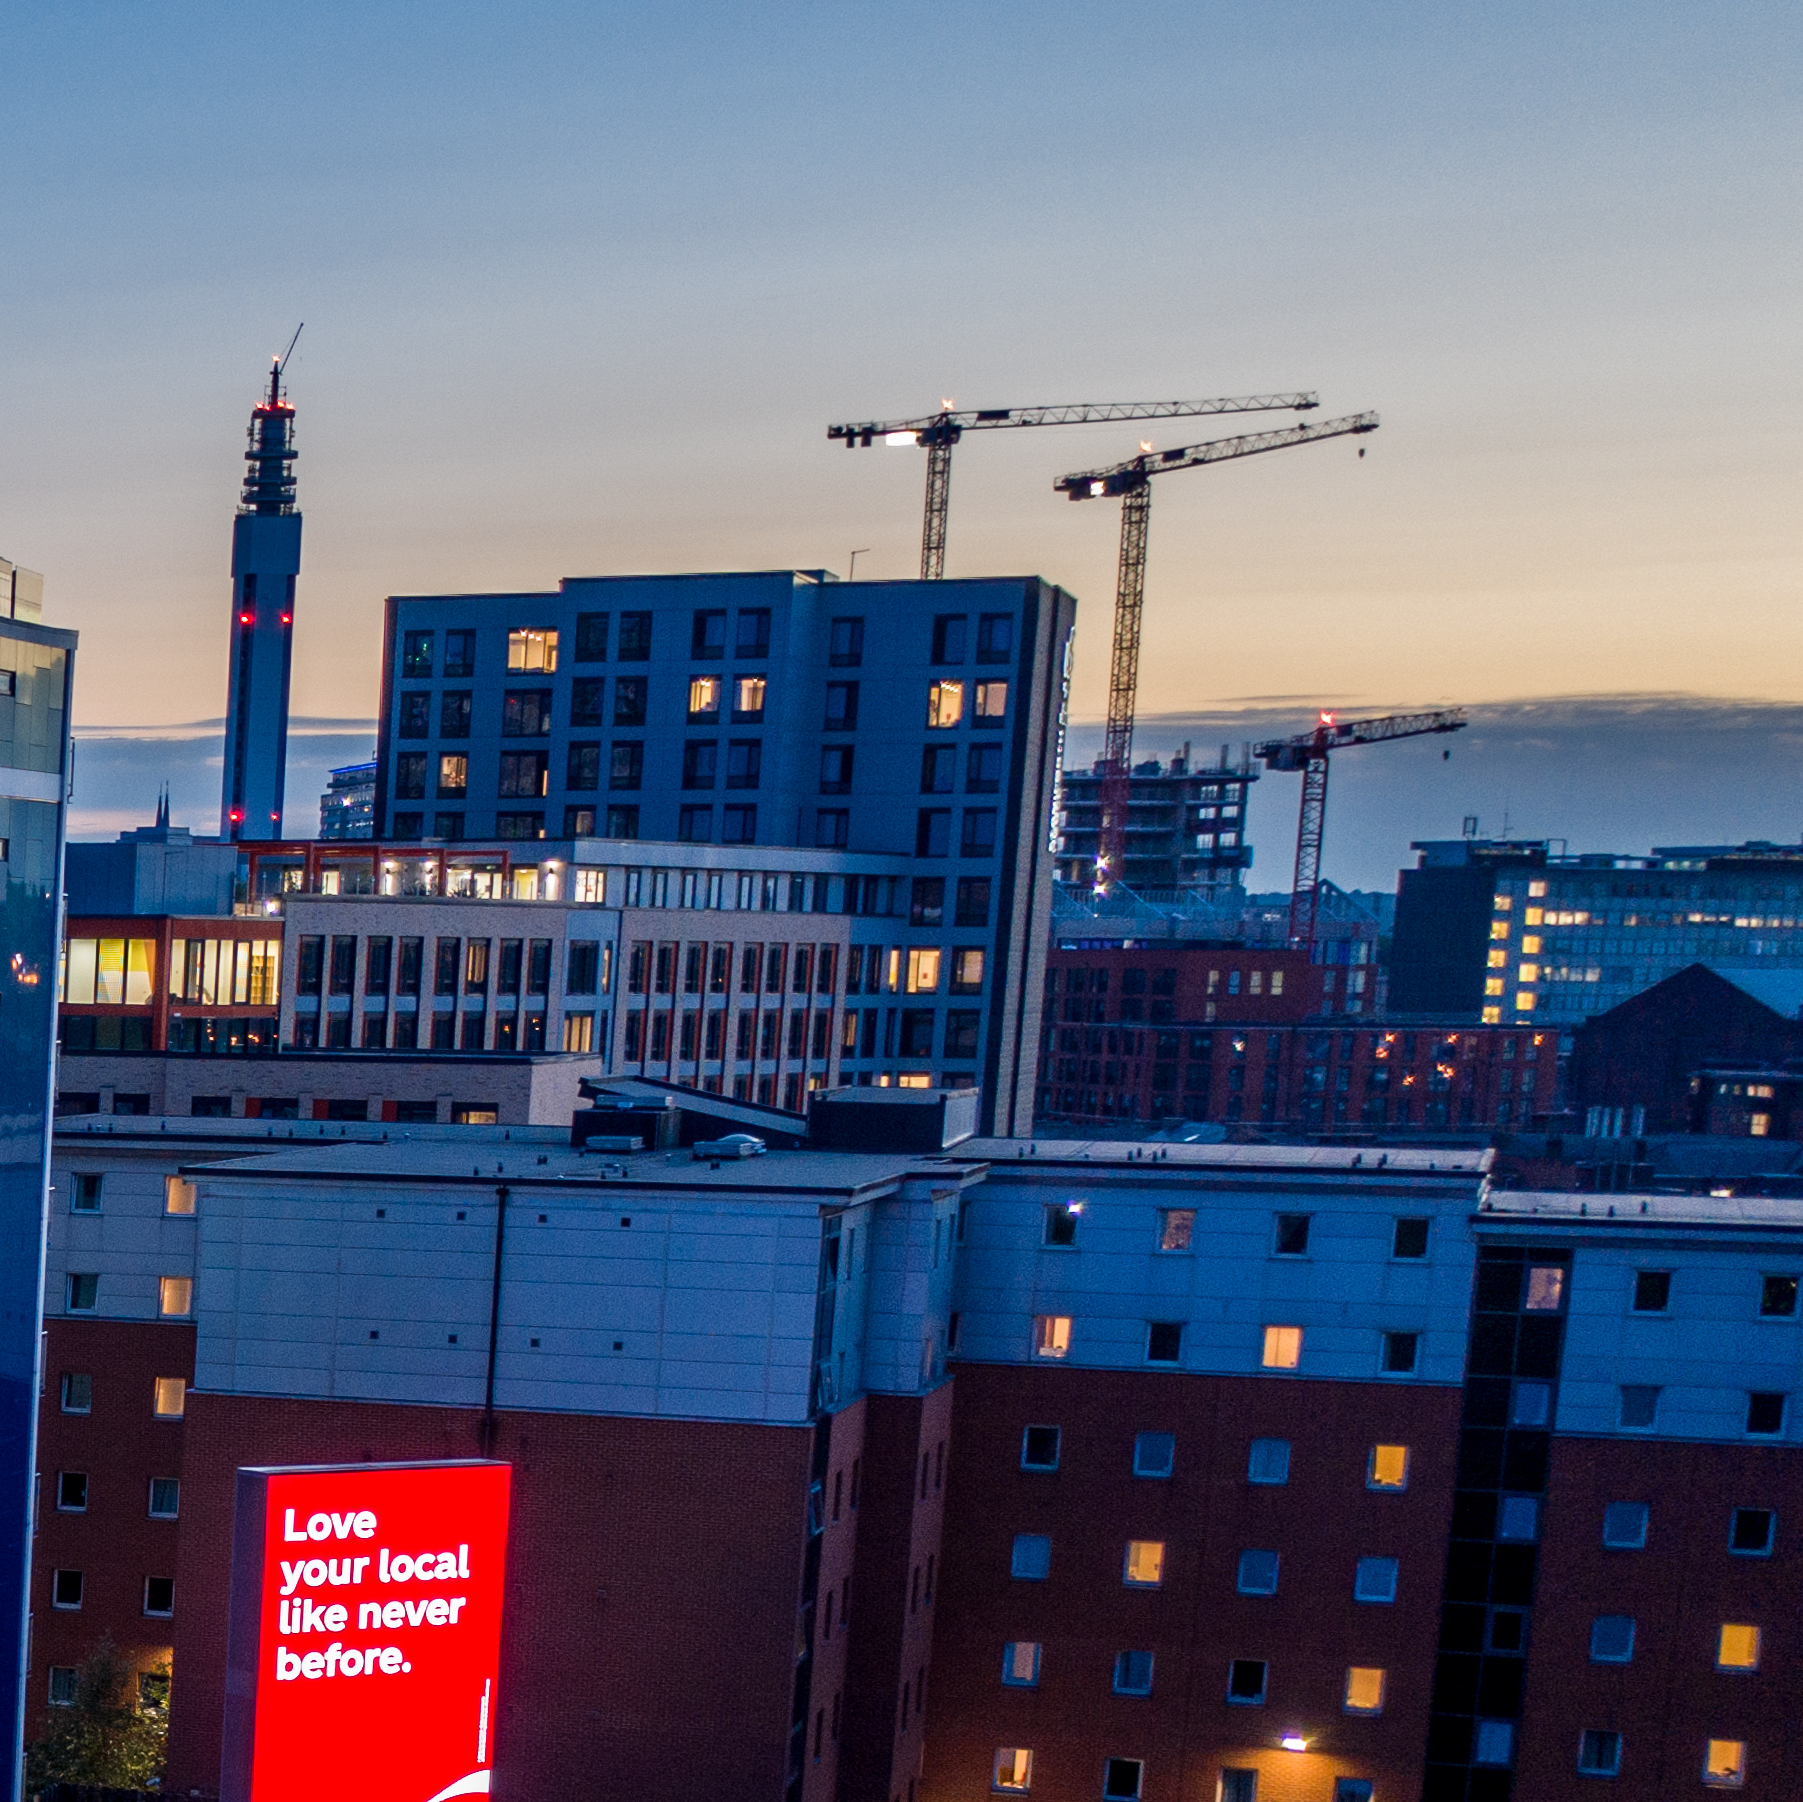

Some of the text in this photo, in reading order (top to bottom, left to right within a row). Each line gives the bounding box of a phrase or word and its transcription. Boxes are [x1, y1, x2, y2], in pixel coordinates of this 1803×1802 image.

[285, 1509, 376, 1541] Love
[280, 1544, 470, 1595] your local
[279, 1597, 467, 1635] like never
[276, 1642, 412, 1681] before.
